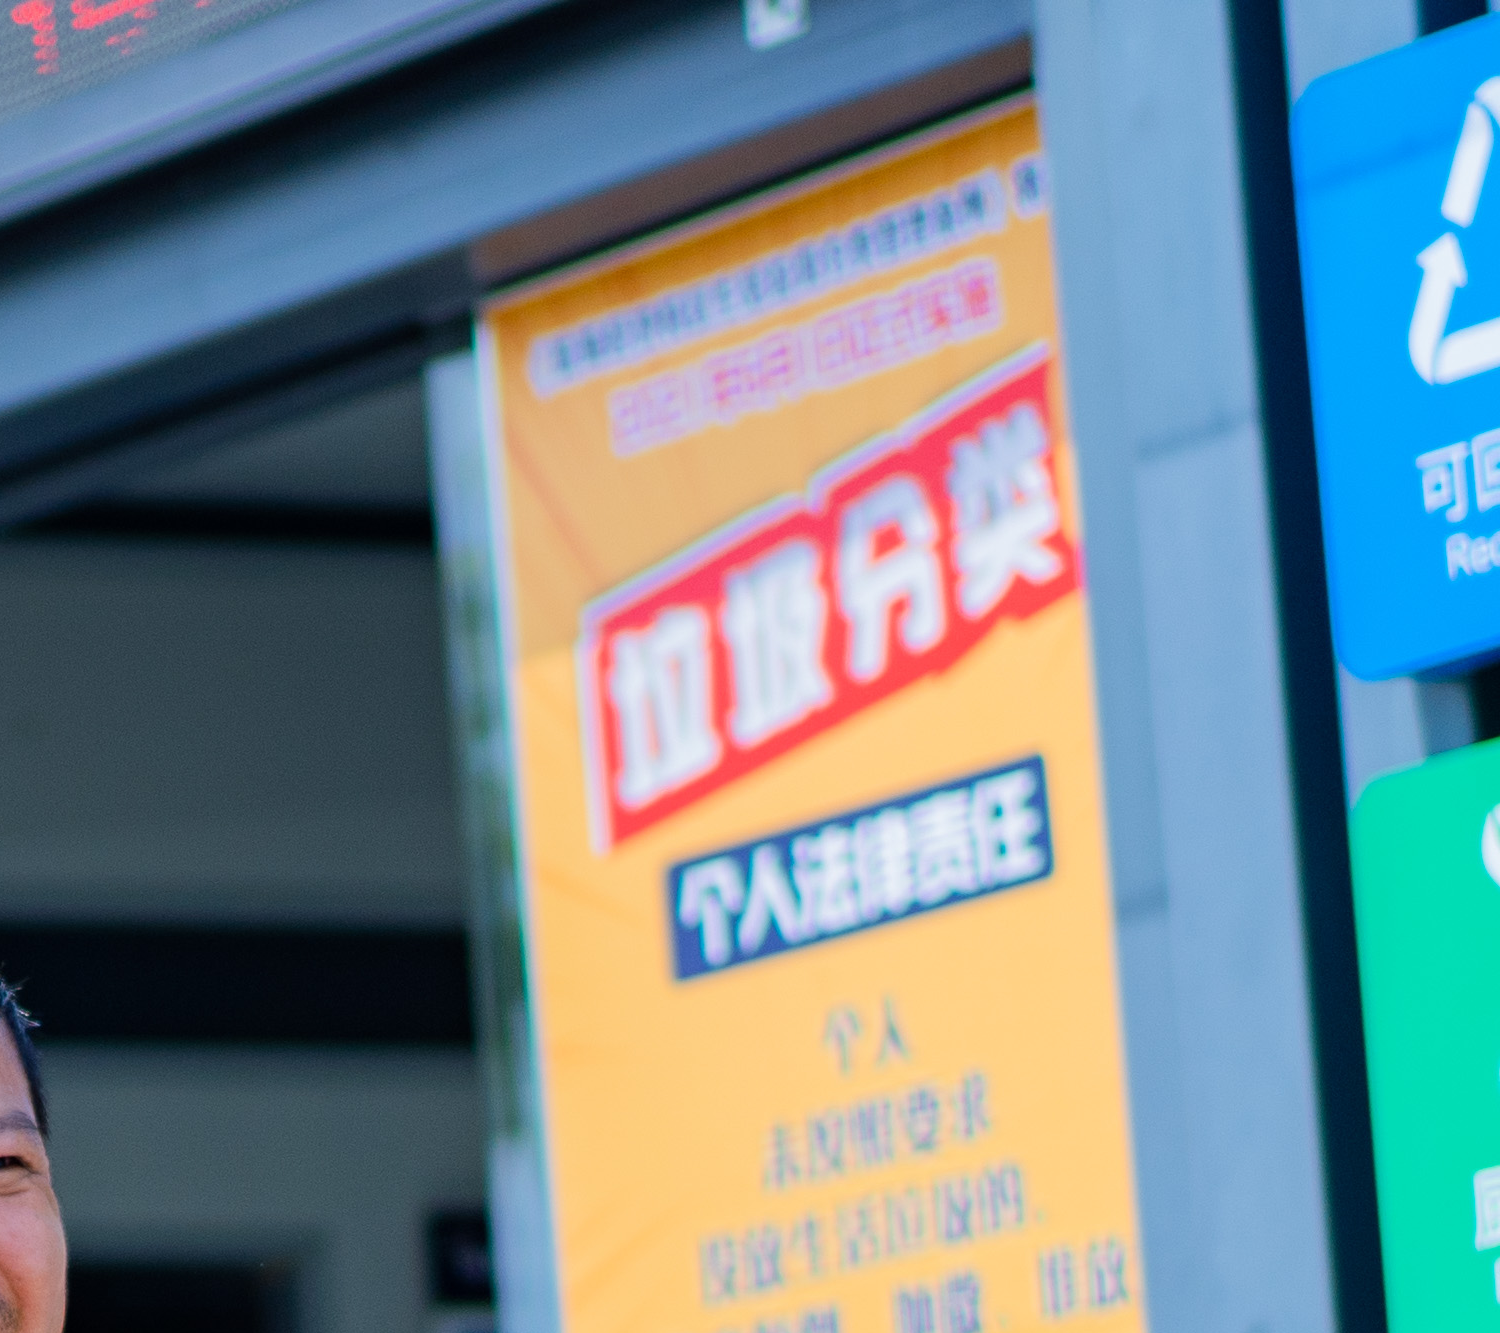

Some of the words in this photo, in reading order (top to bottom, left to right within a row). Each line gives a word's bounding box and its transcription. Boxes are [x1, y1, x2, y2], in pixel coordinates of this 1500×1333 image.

[610, 402, 1062, 812] 垃圾分类
[679, 768, 1046, 965] 个人法律责任
